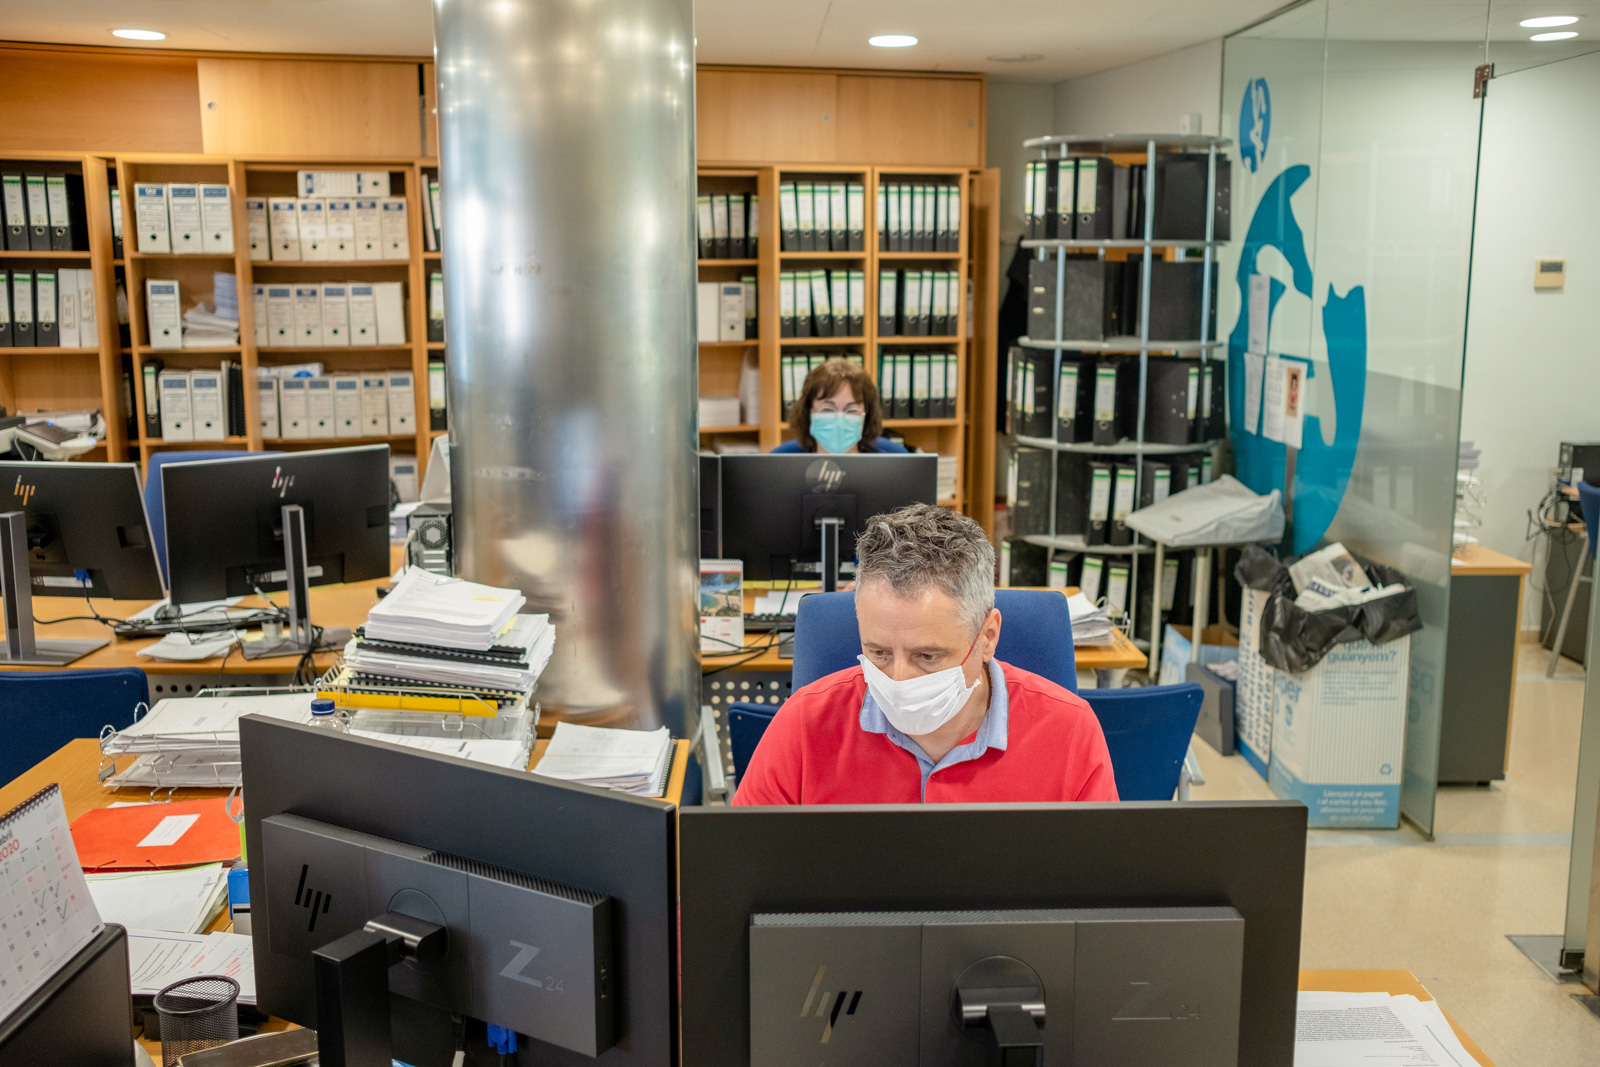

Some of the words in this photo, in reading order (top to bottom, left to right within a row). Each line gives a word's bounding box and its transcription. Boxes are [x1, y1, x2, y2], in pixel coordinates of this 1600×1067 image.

[14, 474, 36, 506] hp
[271, 465, 296, 498] hp
[818, 460, 842, 491] hp
[293, 863, 333, 933] hp
[499, 939, 543, 988] Z
[545, 976, 566, 995] 24
[799, 963, 864, 1045] hp
